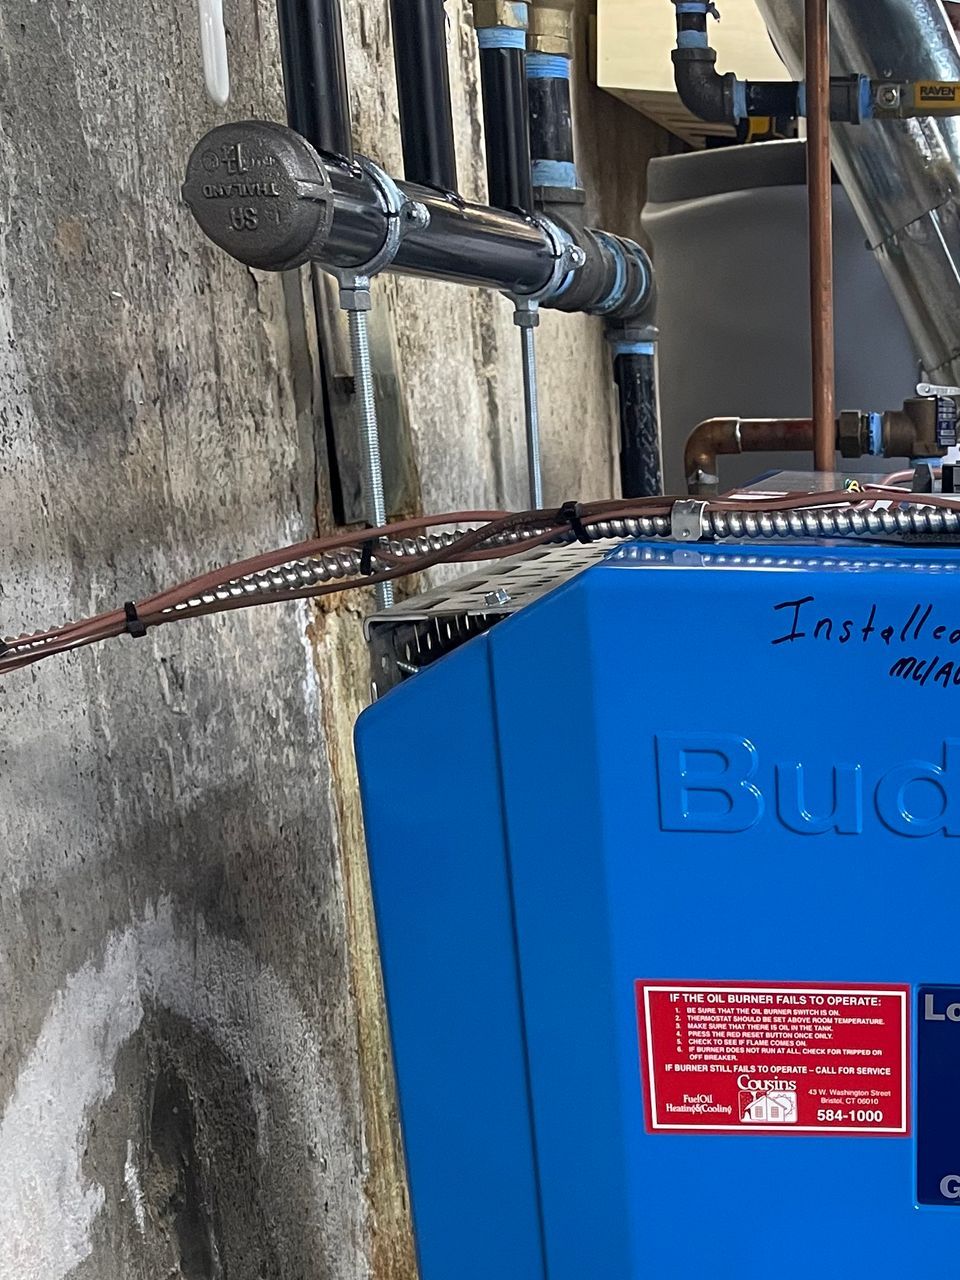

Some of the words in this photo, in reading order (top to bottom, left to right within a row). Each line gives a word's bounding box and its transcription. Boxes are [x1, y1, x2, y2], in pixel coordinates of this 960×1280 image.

[920, 86, 956, 96] RAVEN
[202, 182, 280, 198] THAILAND
[670, 994, 679, 1002] IF
[682, 994, 704, 1003] THE
[707, 994, 725, 1003] OIL
[728, 995, 773, 1004] BURNER
[776, 996, 806, 1005] FAILS
[809, 996, 824, 1005] TO
[827, 996, 882, 1006] OPERATE:
[736, 1073, 797, 1094] Cousins
[683, 1093, 712, 1103] FuelOil
[818, 1110, 883, 1122] 584-1000
